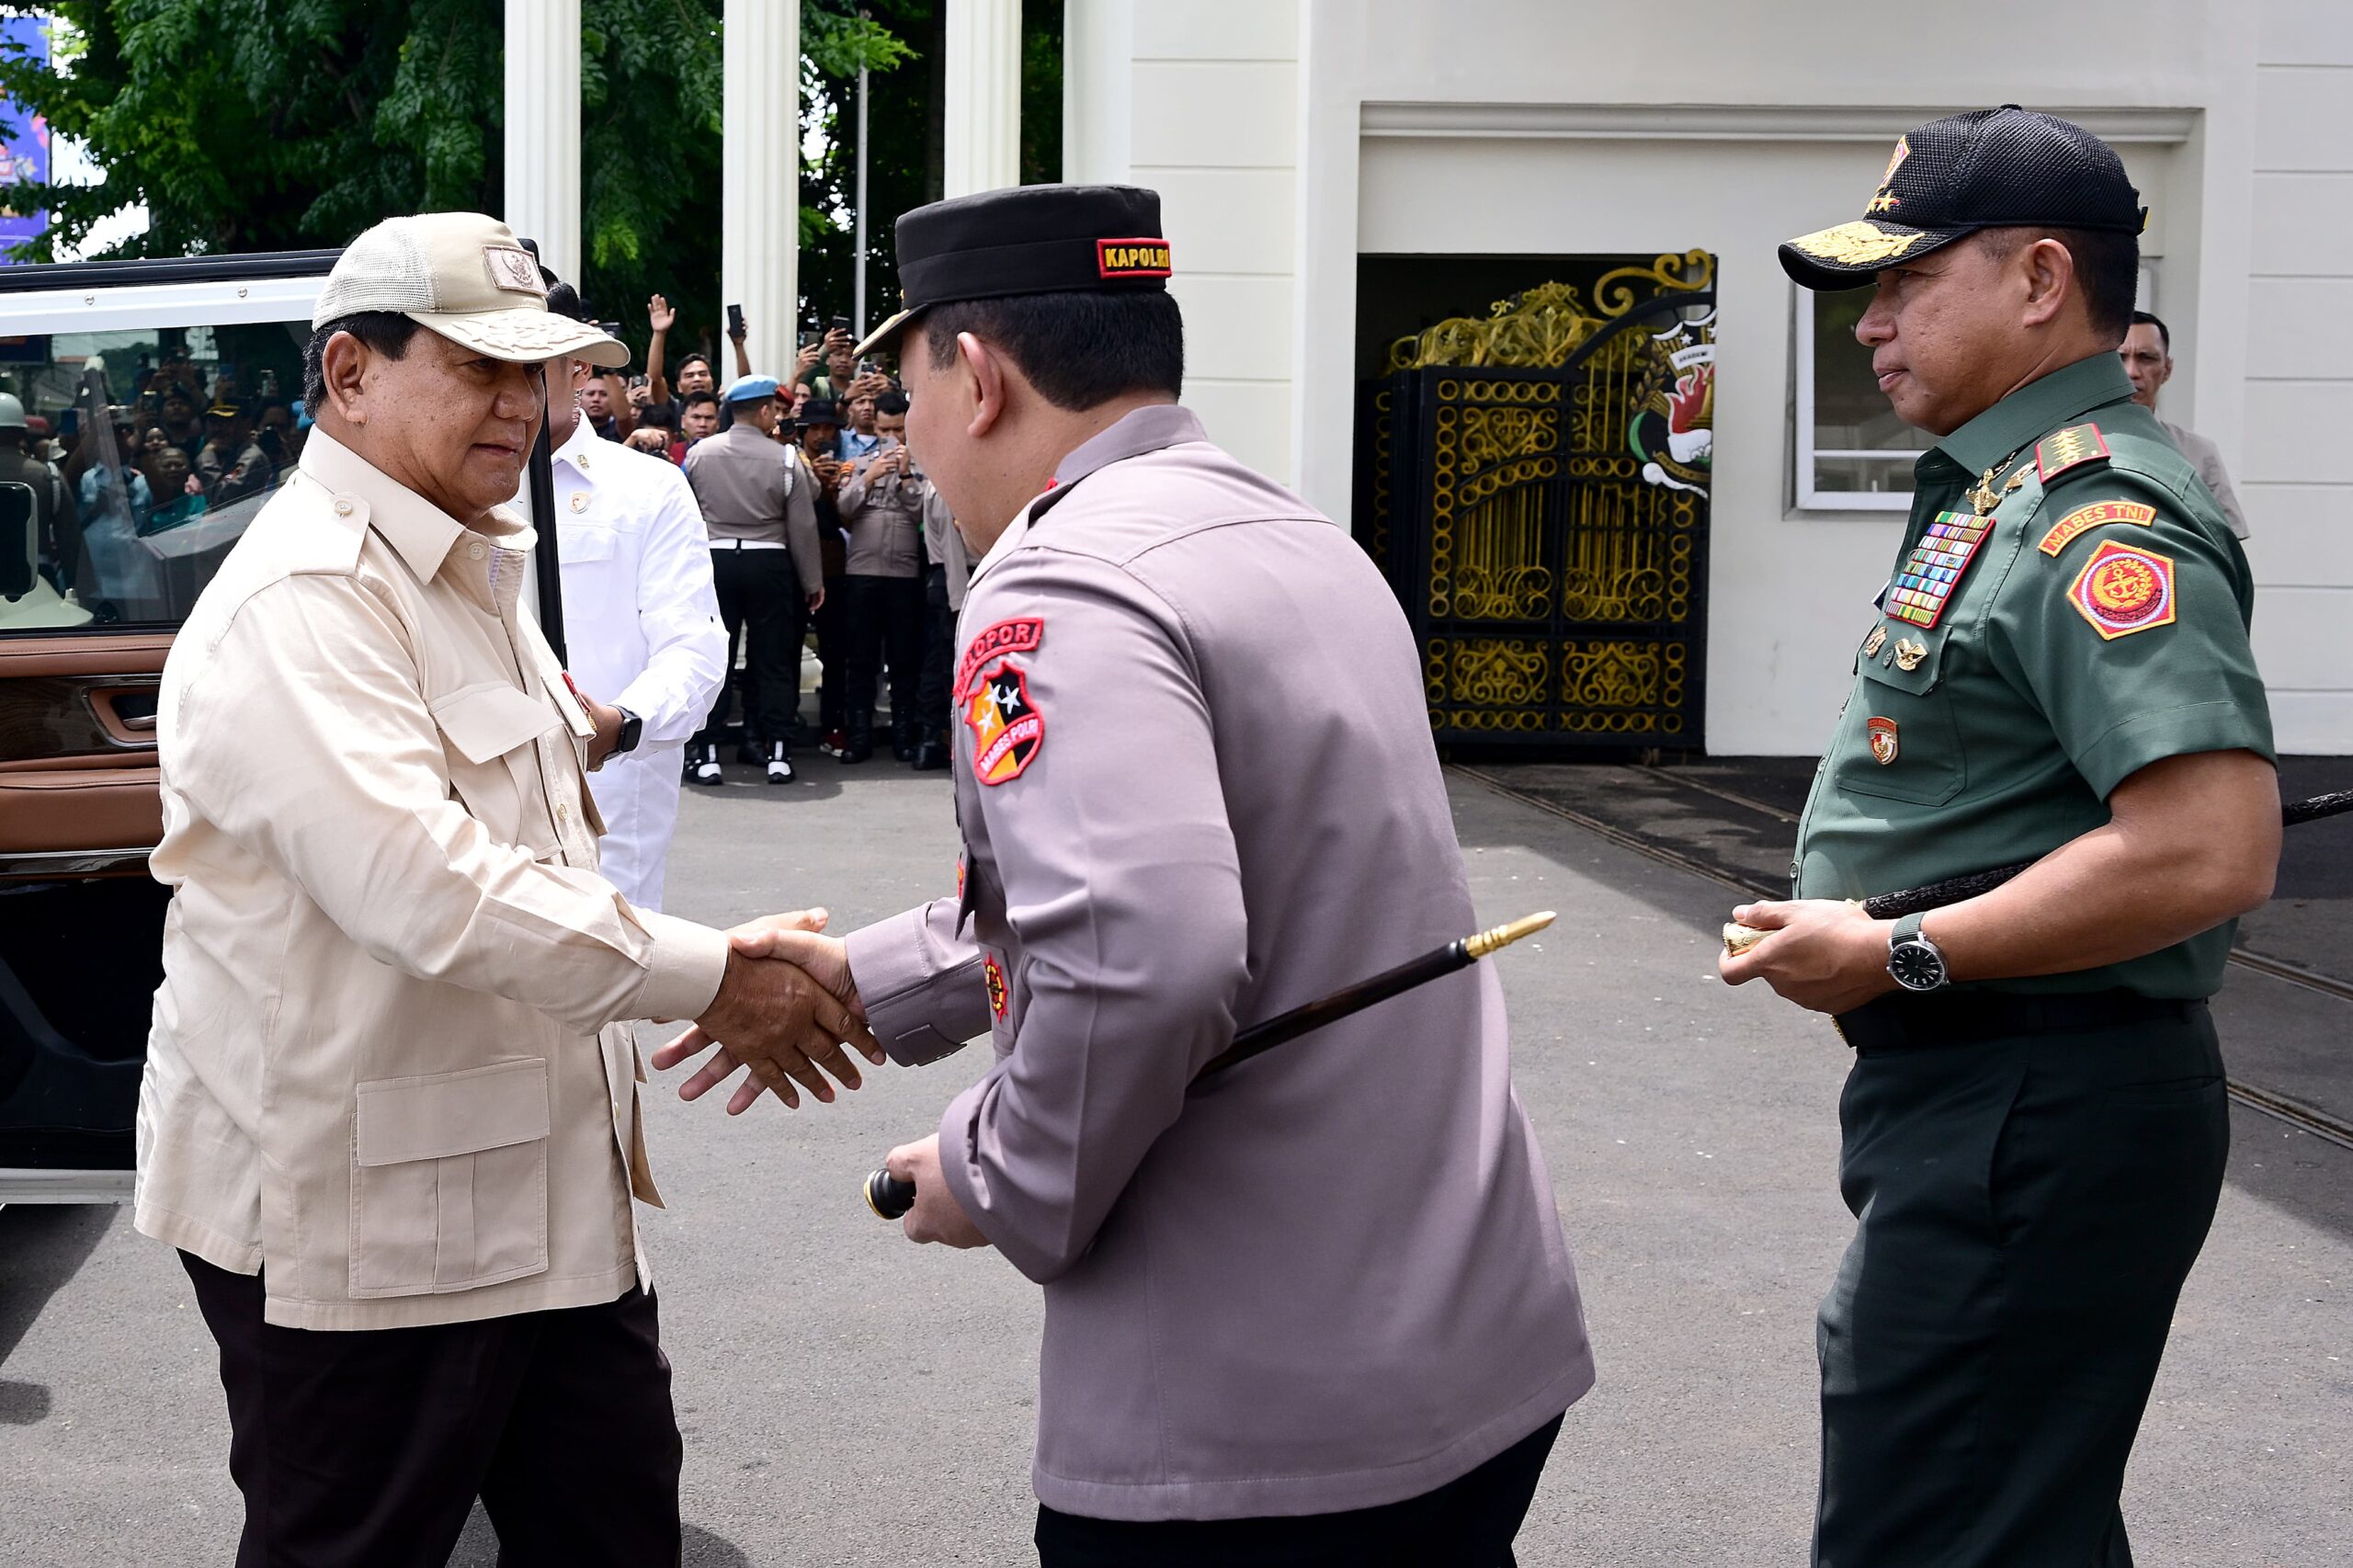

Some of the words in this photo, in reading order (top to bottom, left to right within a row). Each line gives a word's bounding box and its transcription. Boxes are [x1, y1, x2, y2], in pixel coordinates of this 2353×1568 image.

[1105, 248, 1169, 267] KAPOLRI
[2048, 506, 2107, 548] MABES
[2112, 505, 2144, 520] TNI
[980, 733, 1013, 773] MABES
[1010, 718, 1039, 744] POLRI
